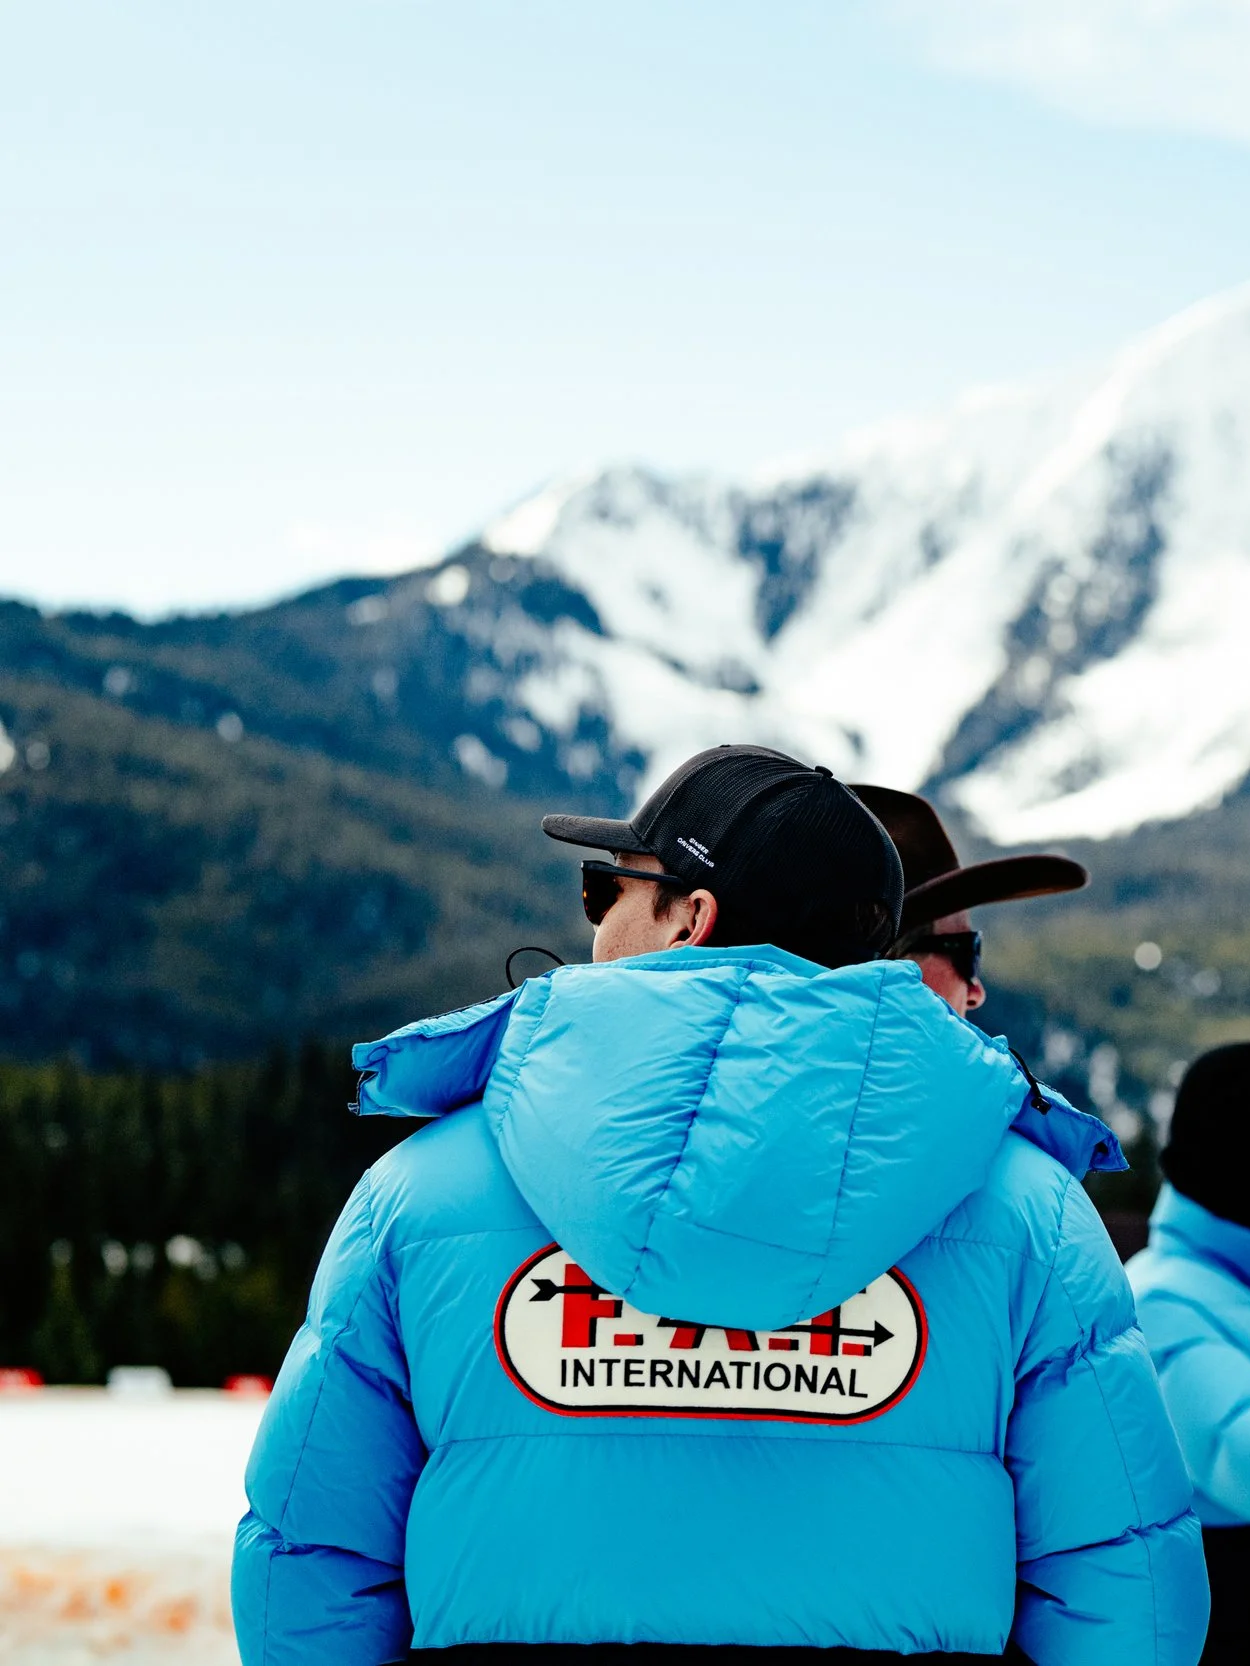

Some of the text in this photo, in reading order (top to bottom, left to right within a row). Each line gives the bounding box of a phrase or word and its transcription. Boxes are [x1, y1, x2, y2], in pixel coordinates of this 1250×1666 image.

[677, 837, 715, 868] DRIVERS CLUB
[560, 1358, 869, 1399] INTERNATIONAL
